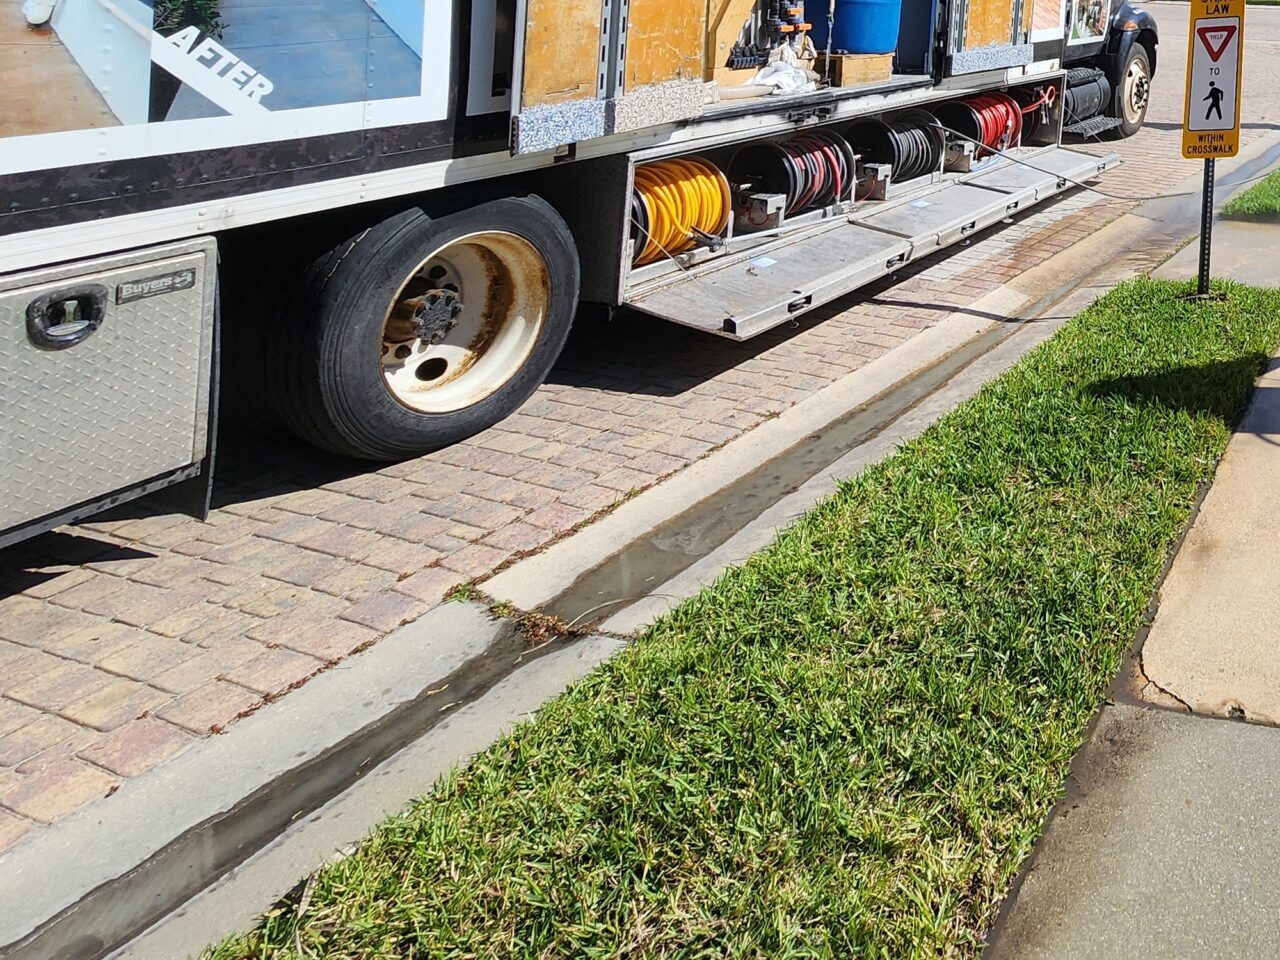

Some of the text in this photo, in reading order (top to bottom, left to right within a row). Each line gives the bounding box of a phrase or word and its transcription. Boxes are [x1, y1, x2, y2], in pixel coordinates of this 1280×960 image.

[1206, 4, 1230, 15] LAW
[1209, 33, 1224, 41] YIELD
[164, 24, 274, 104] AFTER
[1209, 67, 1220, 76] TO
[1197, 133, 1224, 143] WITHIN
[1187, 144, 1234, 154] CROSSWALK
[122, 276, 173, 296] Buyers
